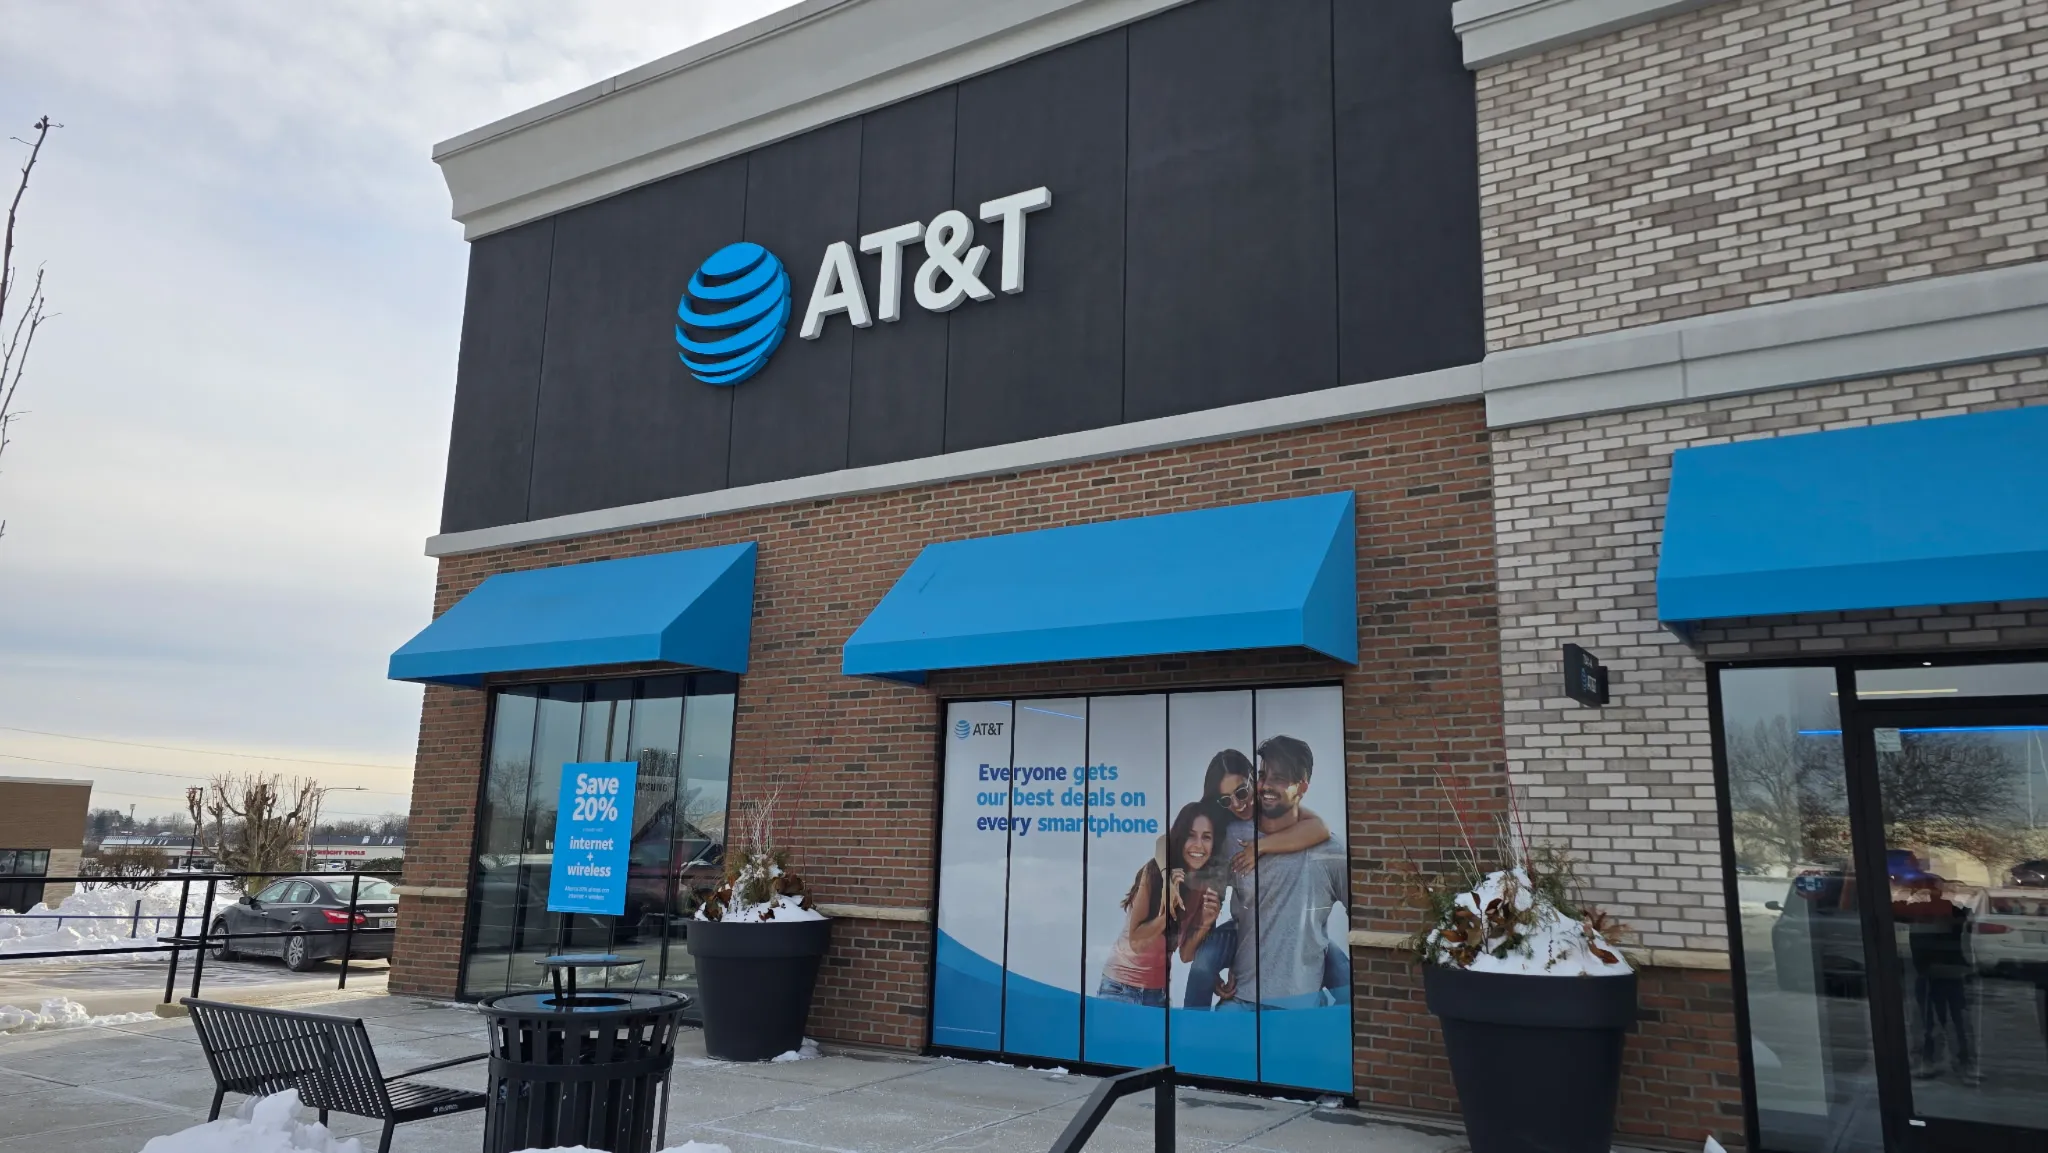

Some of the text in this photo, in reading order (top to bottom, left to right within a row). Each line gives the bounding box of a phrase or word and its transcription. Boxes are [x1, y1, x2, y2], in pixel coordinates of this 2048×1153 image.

[800, 186, 1052, 340] AT&T
[972, 722, 1004, 736] AT&T
[576, 773, 619, 794] Save
[979, 762, 1119, 786] Everyone gets
[976, 787, 1146, 807] our best deals on
[573, 797, 618, 821] 20%
[976, 812, 1158, 837] every smartphone
[570, 836, 614, 850] internet
[568, 863, 611, 876] wireless
